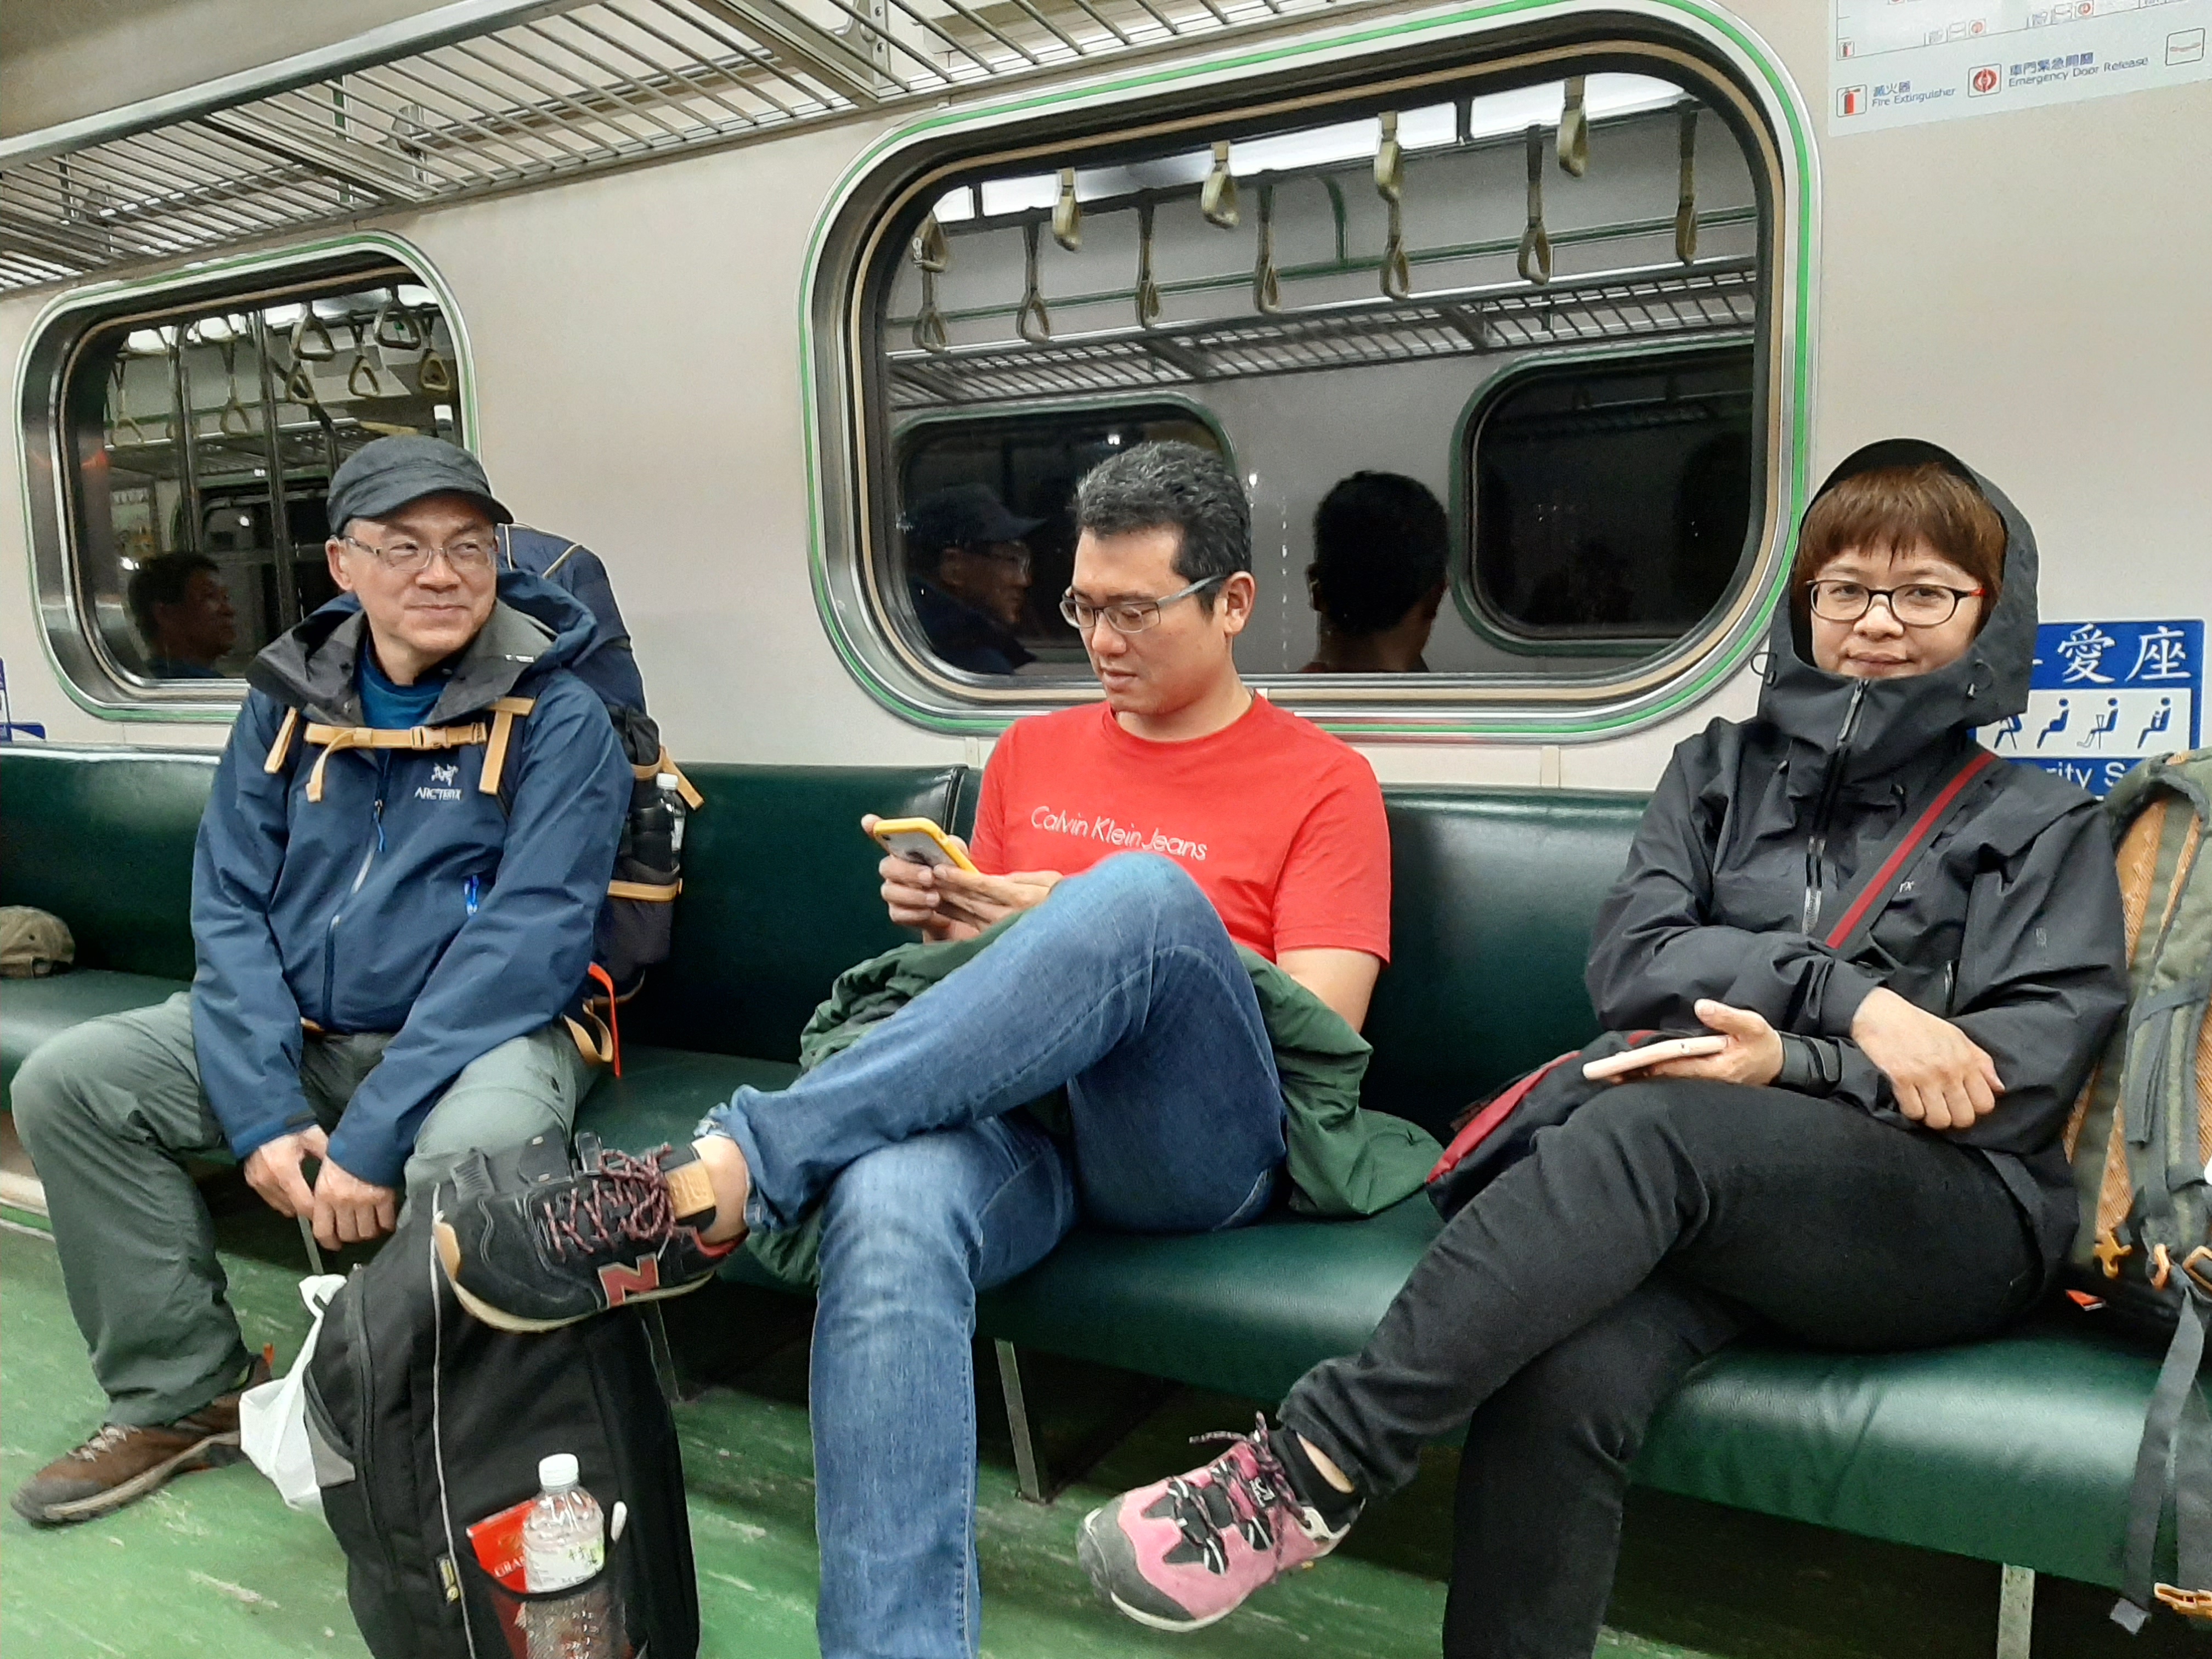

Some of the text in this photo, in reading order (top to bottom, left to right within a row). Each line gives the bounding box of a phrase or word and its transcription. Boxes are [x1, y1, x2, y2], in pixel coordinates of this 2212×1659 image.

[1872, 88, 1956, 107] Fire Extinguisher
[2008, 57, 2149, 87] Emergency Door Release
[2033, 624, 2192, 684] 愛座
[1031, 805, 1209, 861] Calvin Klein Jeans
[597, 1251, 660, 1309] N
